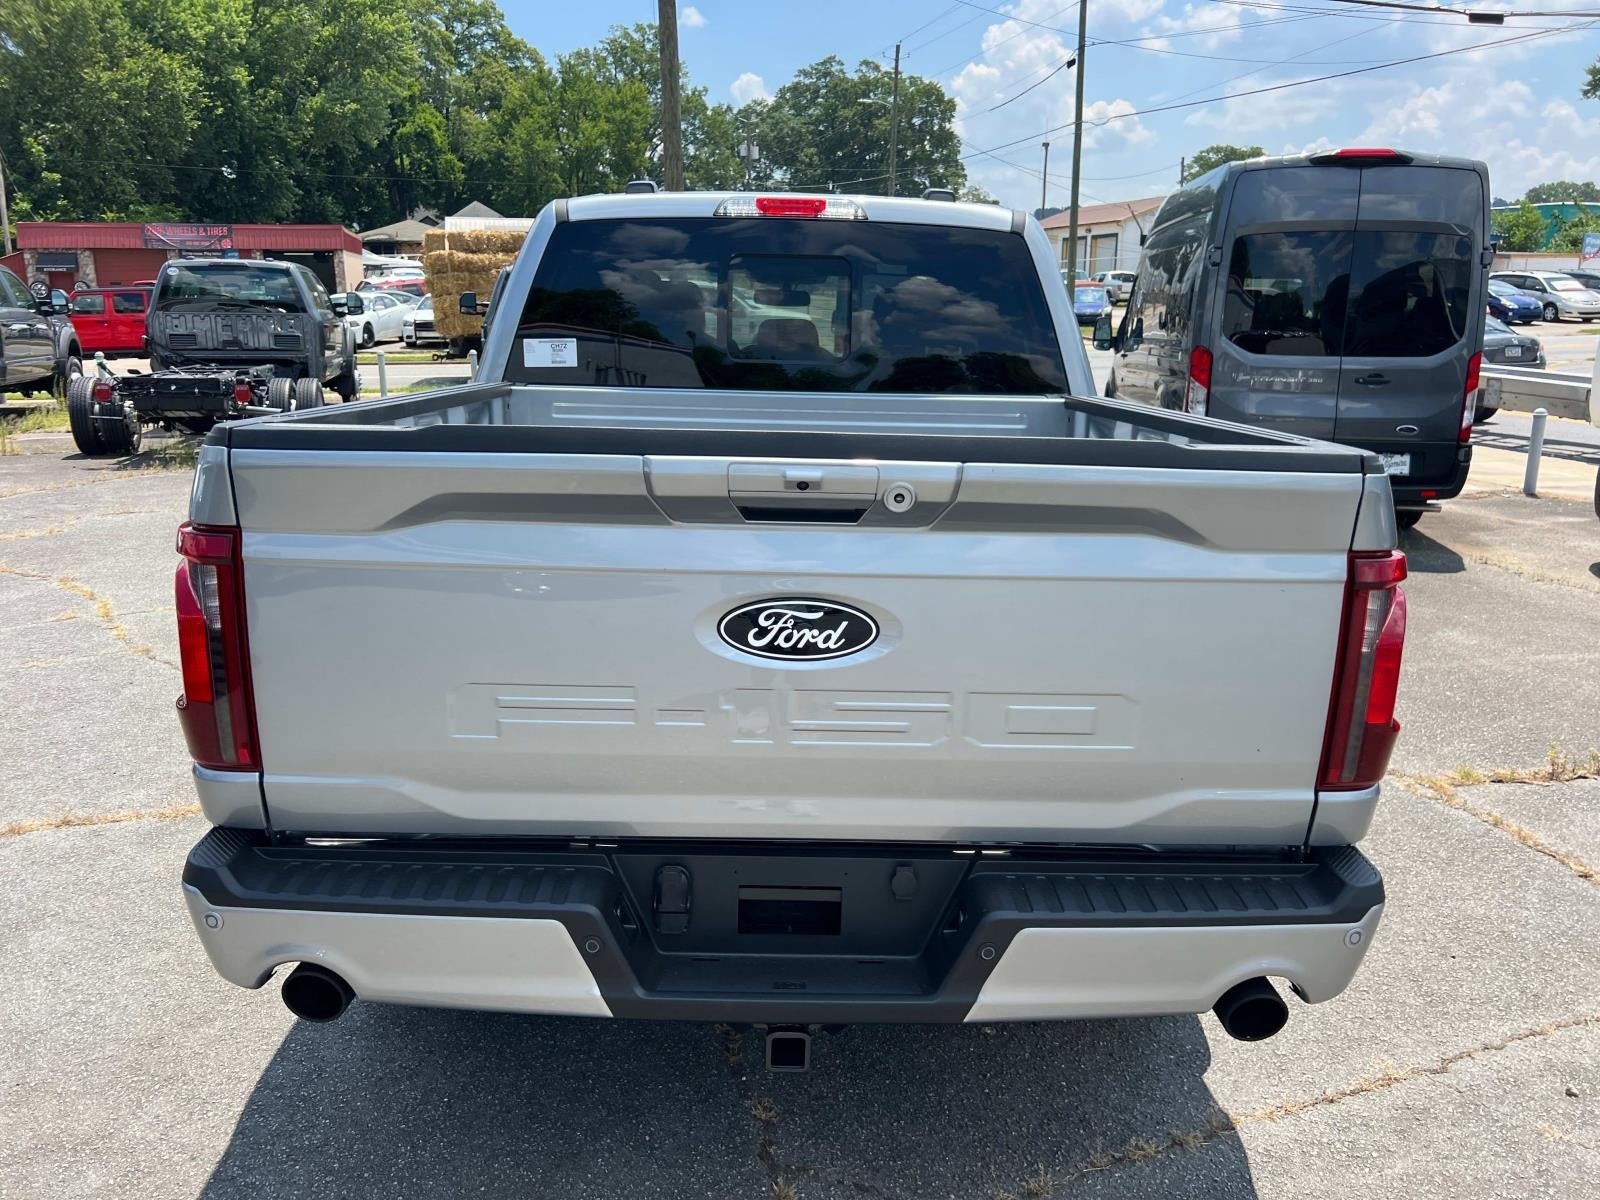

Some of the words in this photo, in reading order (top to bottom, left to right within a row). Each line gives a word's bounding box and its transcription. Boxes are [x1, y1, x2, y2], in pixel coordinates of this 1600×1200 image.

[207, 226, 228, 236] TIRES
[747, 608, 849, 650] Ford
[447, 683, 1140, 750] F-150
